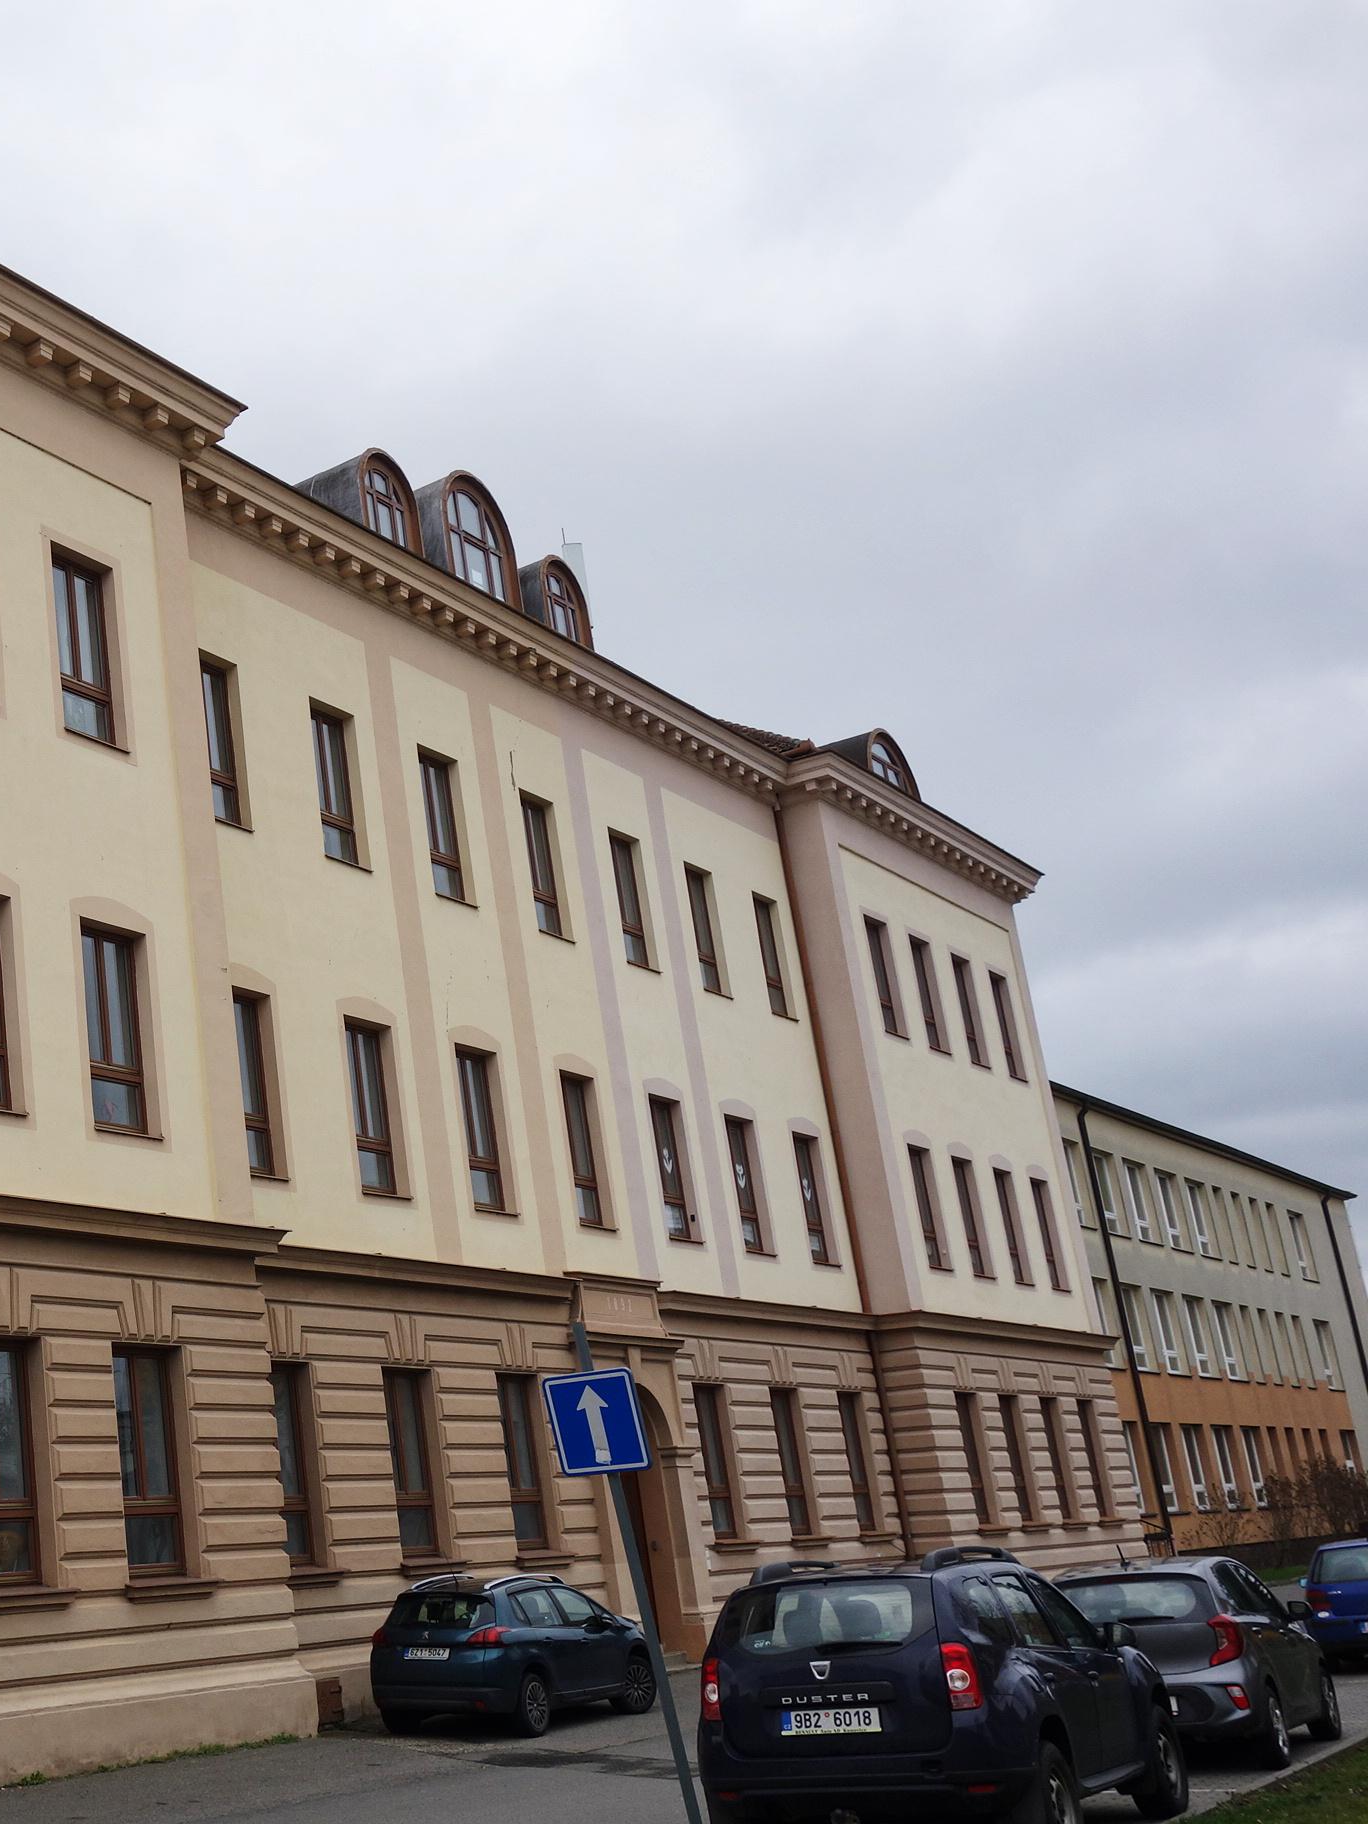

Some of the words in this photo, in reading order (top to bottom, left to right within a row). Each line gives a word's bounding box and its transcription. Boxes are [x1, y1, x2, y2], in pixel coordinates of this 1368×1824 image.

[428, 1648, 447, 1657] 5047
[781, 1693, 869, 1704] DUSTER
[794, 1712, 822, 1729] 9B2
[833, 1710, 872, 1727] 6018
